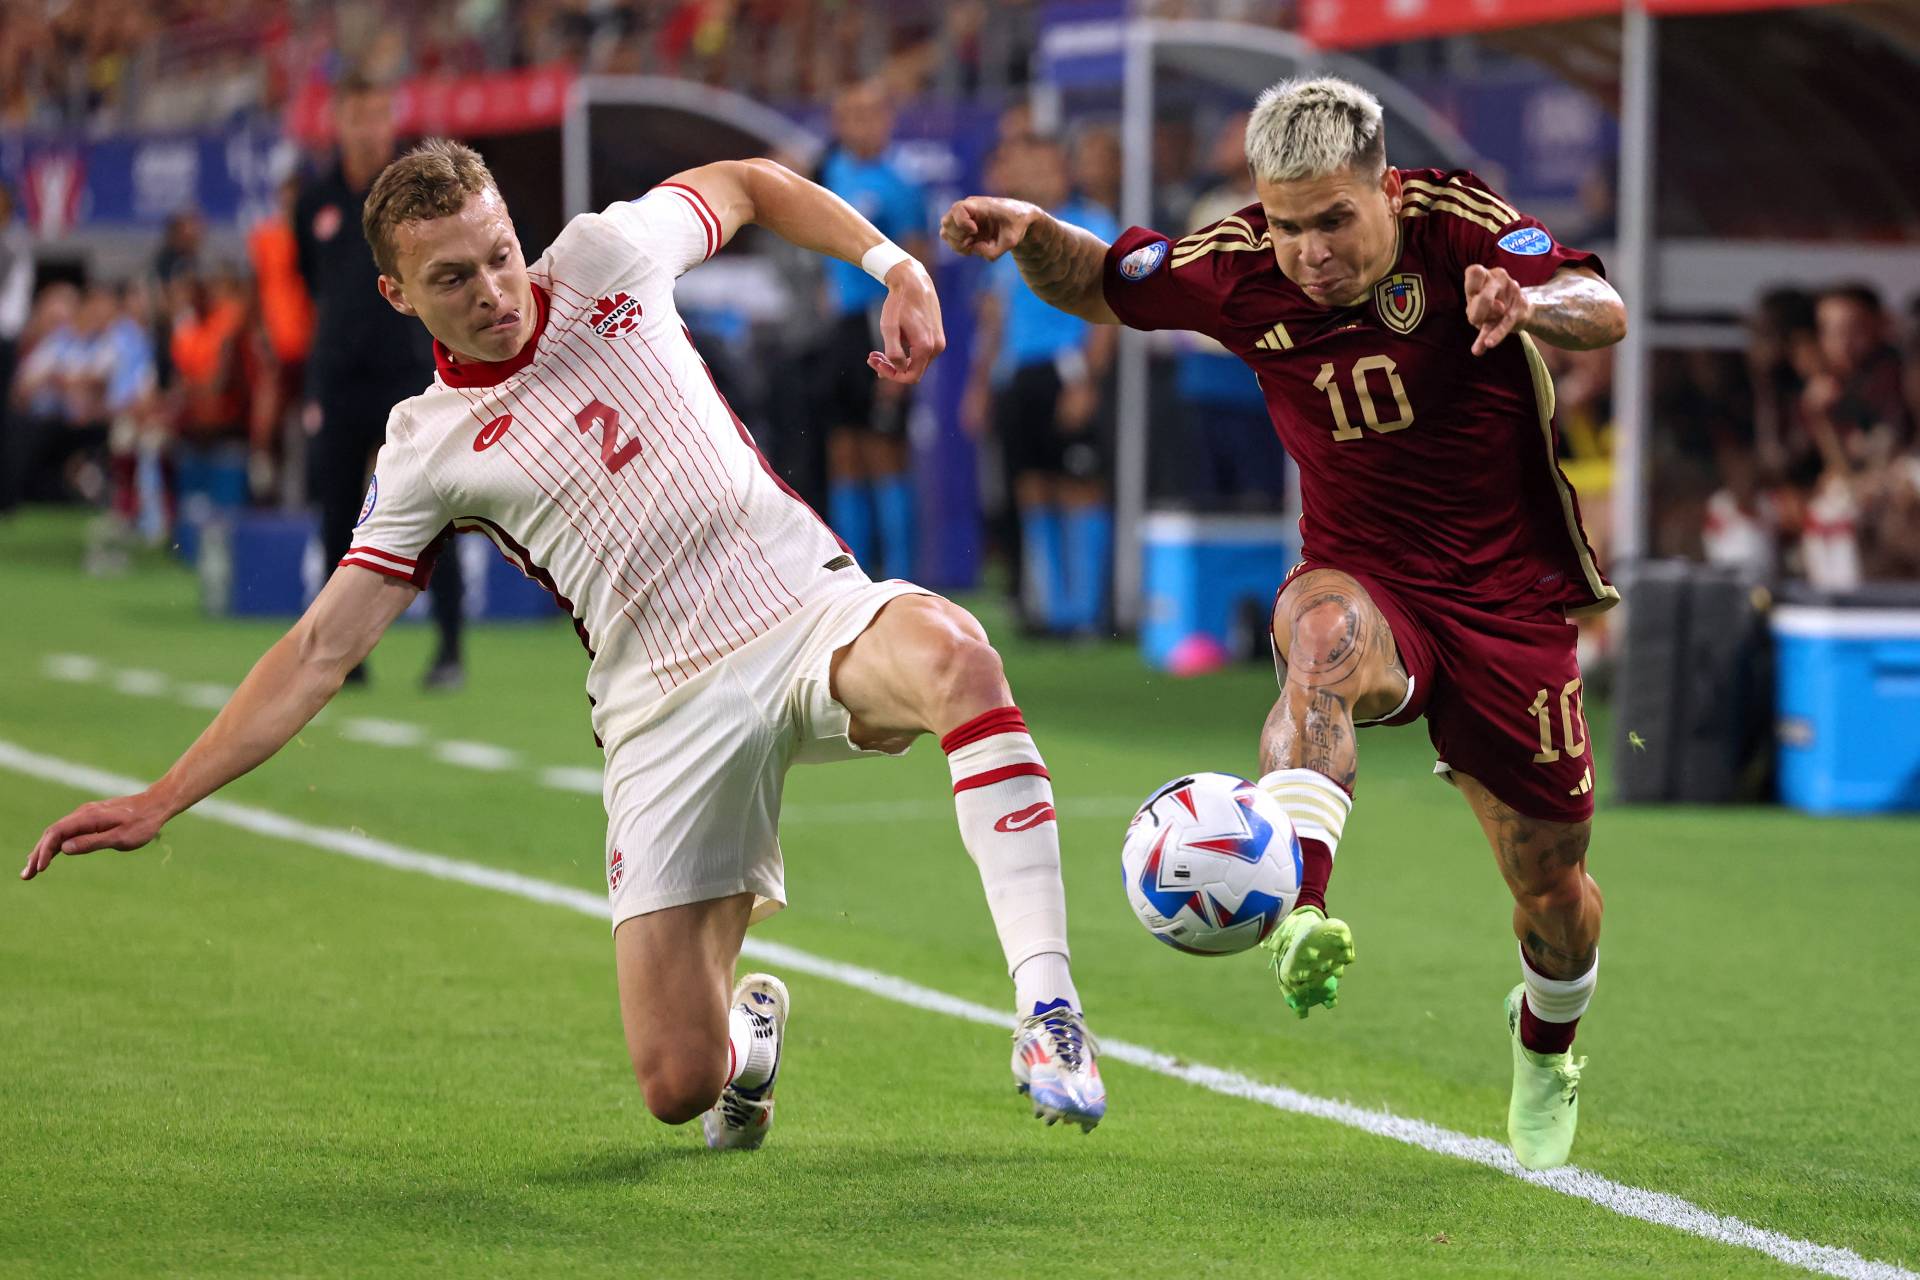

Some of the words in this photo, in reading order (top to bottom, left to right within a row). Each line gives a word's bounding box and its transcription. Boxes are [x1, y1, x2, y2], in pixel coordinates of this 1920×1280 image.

[595, 298, 639, 335] CANADA
[574, 399, 643, 475] 2
[1312, 354, 1415, 442] 10
[1527, 677, 1586, 763] 10
